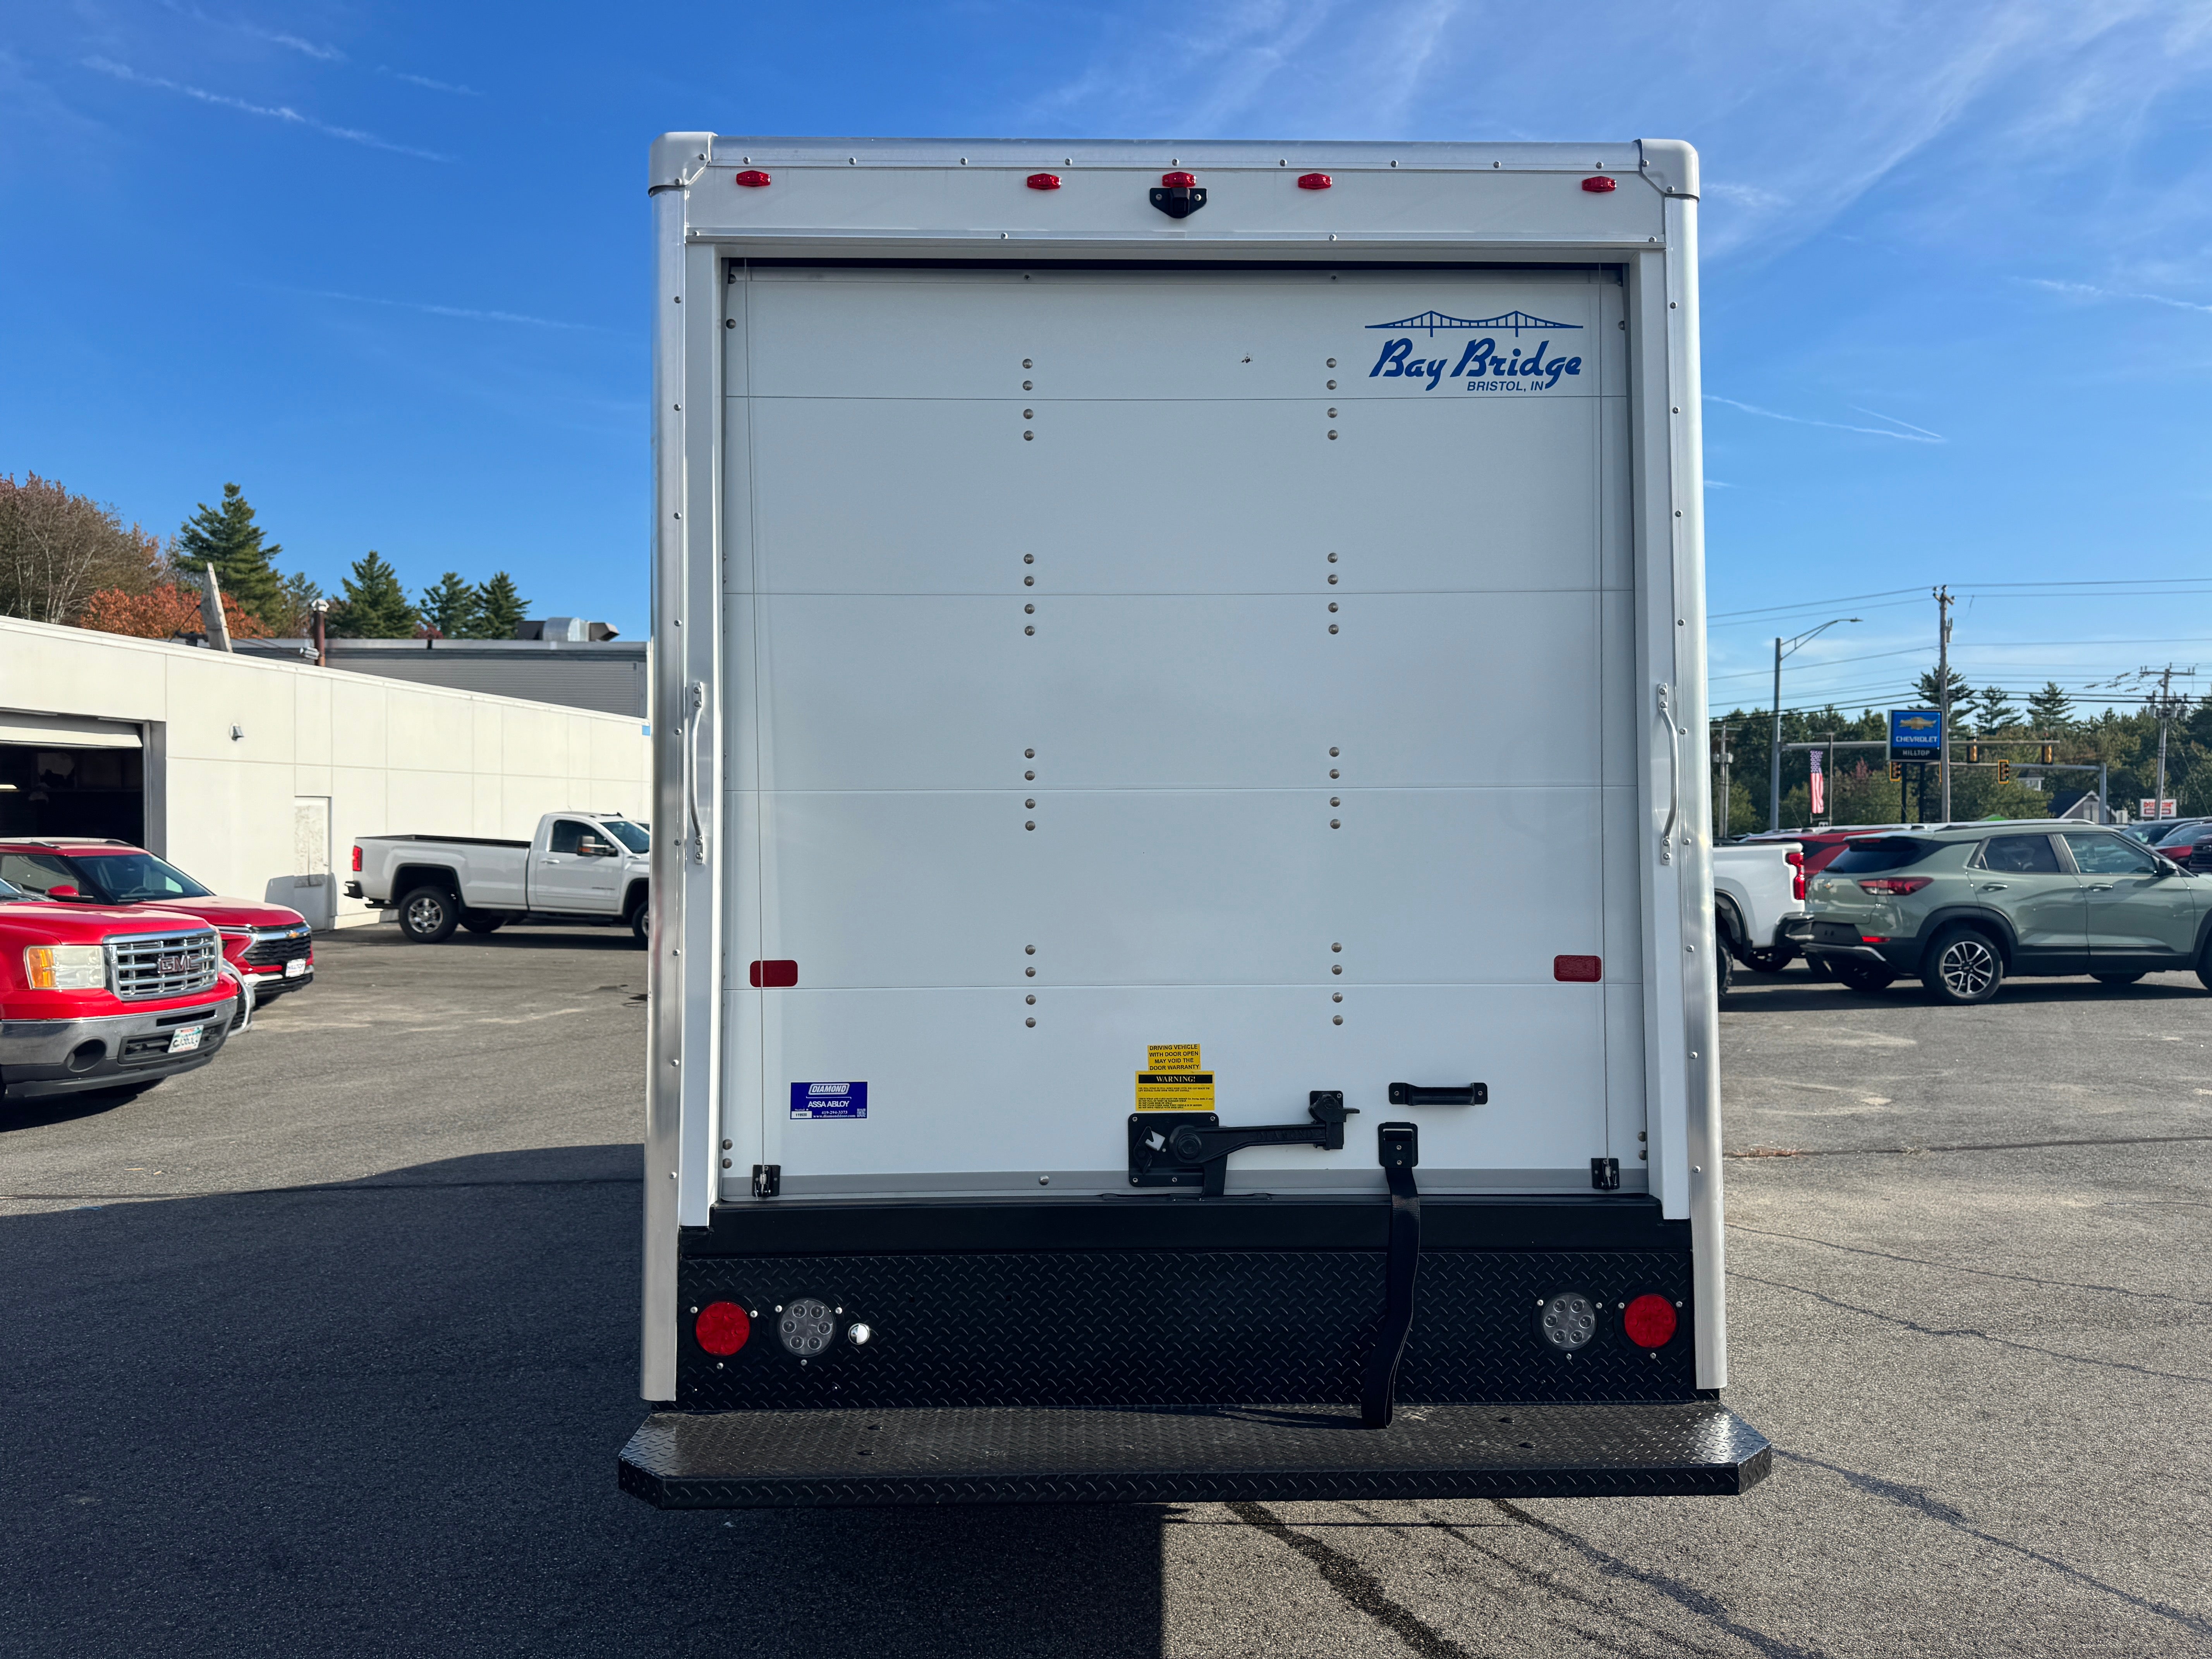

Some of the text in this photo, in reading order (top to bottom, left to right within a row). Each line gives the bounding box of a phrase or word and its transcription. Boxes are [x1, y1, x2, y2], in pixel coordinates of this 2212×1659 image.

[1369, 338, 1582, 391] Bay Bridge
[1467, 381, 1544, 392] BRISTOL, IN
[158, 953, 200, 973] GMC
